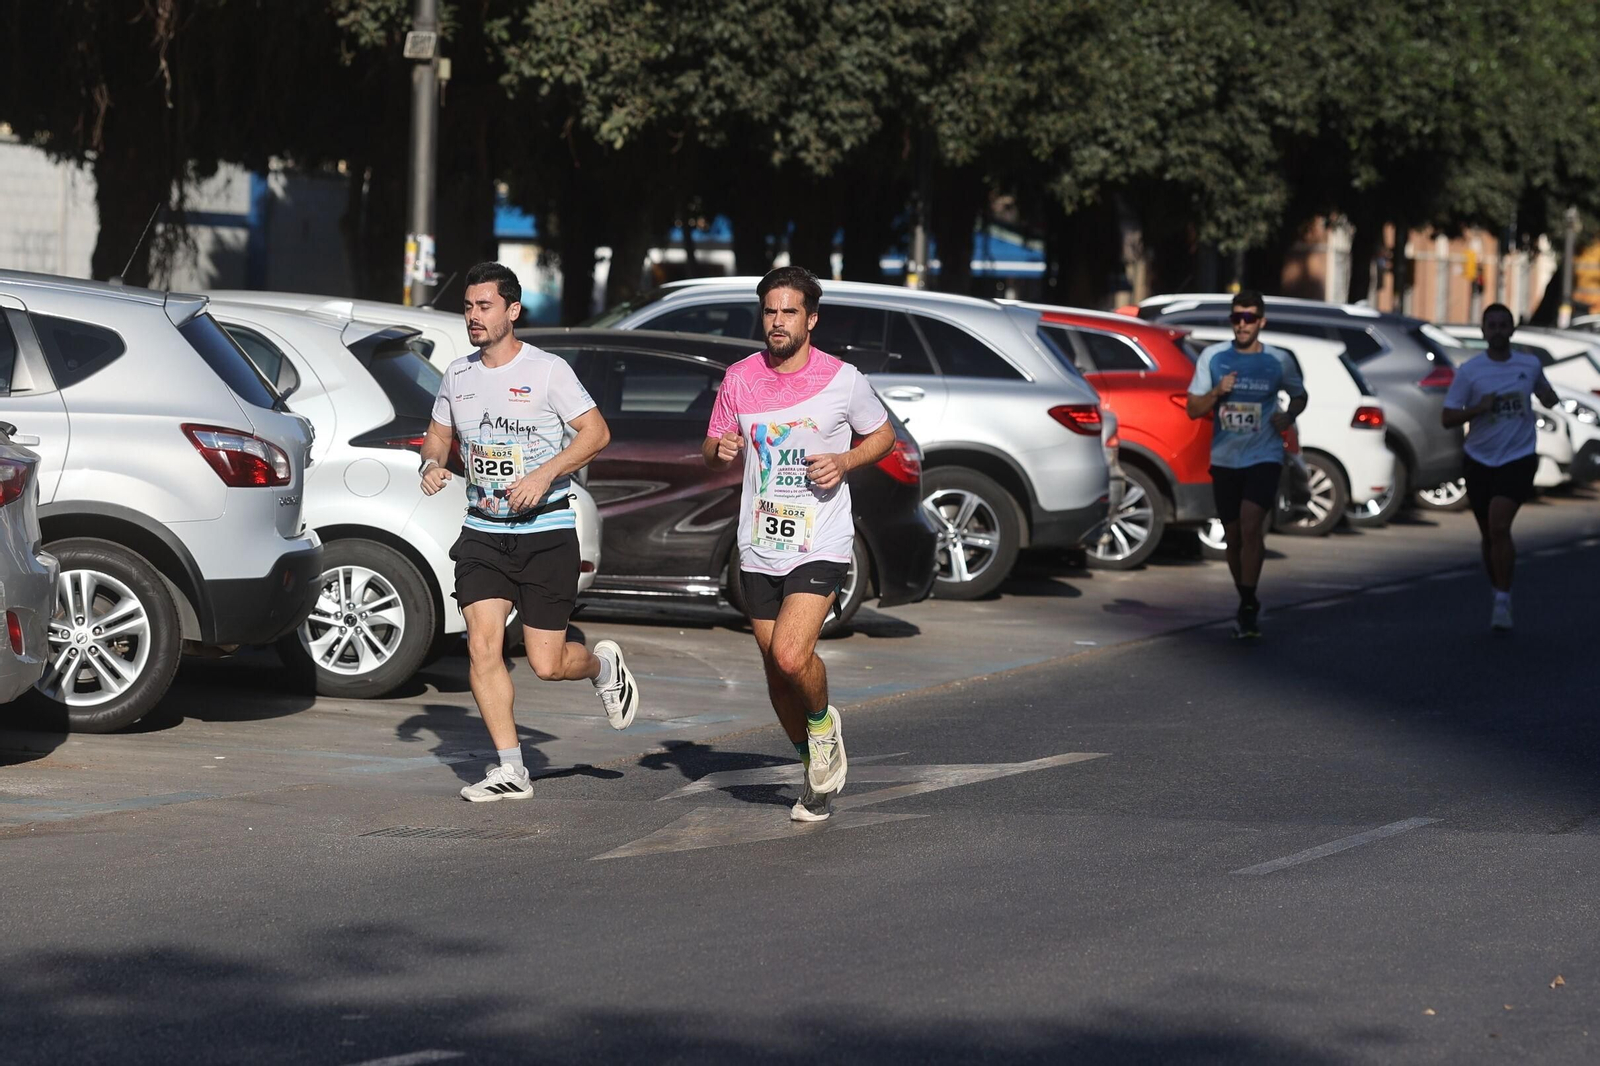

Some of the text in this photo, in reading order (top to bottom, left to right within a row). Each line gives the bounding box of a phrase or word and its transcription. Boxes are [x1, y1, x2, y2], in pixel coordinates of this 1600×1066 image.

[495, 416, 538, 440] Málaga
[1226, 414, 1254, 424] 114
[777, 448, 806, 466] XII
[474, 458, 514, 476] 326
[759, 499, 774, 512] XII
[782, 509, 805, 518] 2025
[765, 516, 796, 537] 36
